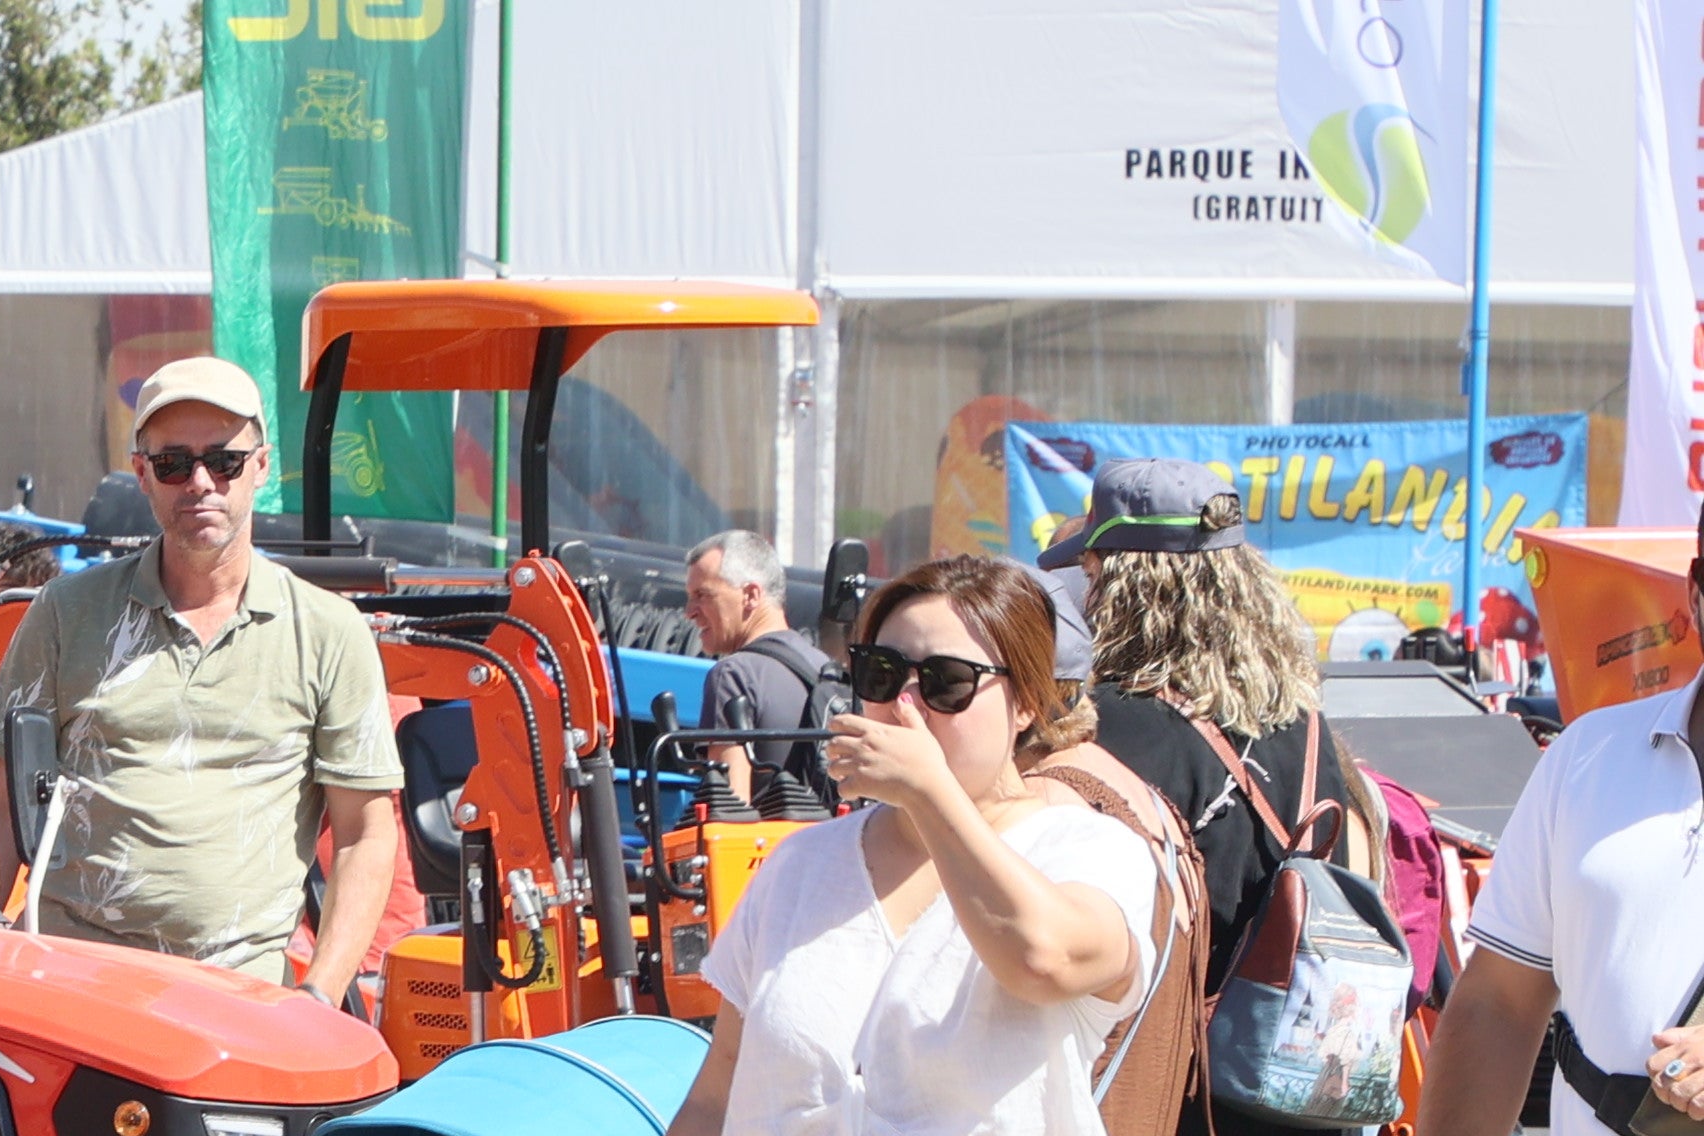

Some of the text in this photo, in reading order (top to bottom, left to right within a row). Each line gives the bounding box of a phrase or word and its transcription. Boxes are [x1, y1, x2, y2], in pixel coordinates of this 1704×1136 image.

[1125, 149, 1310, 181] PARQUE IN
[1193, 195, 1324, 222] (GRATUIT
[1245, 434, 1372, 449] PHOTOCALL
